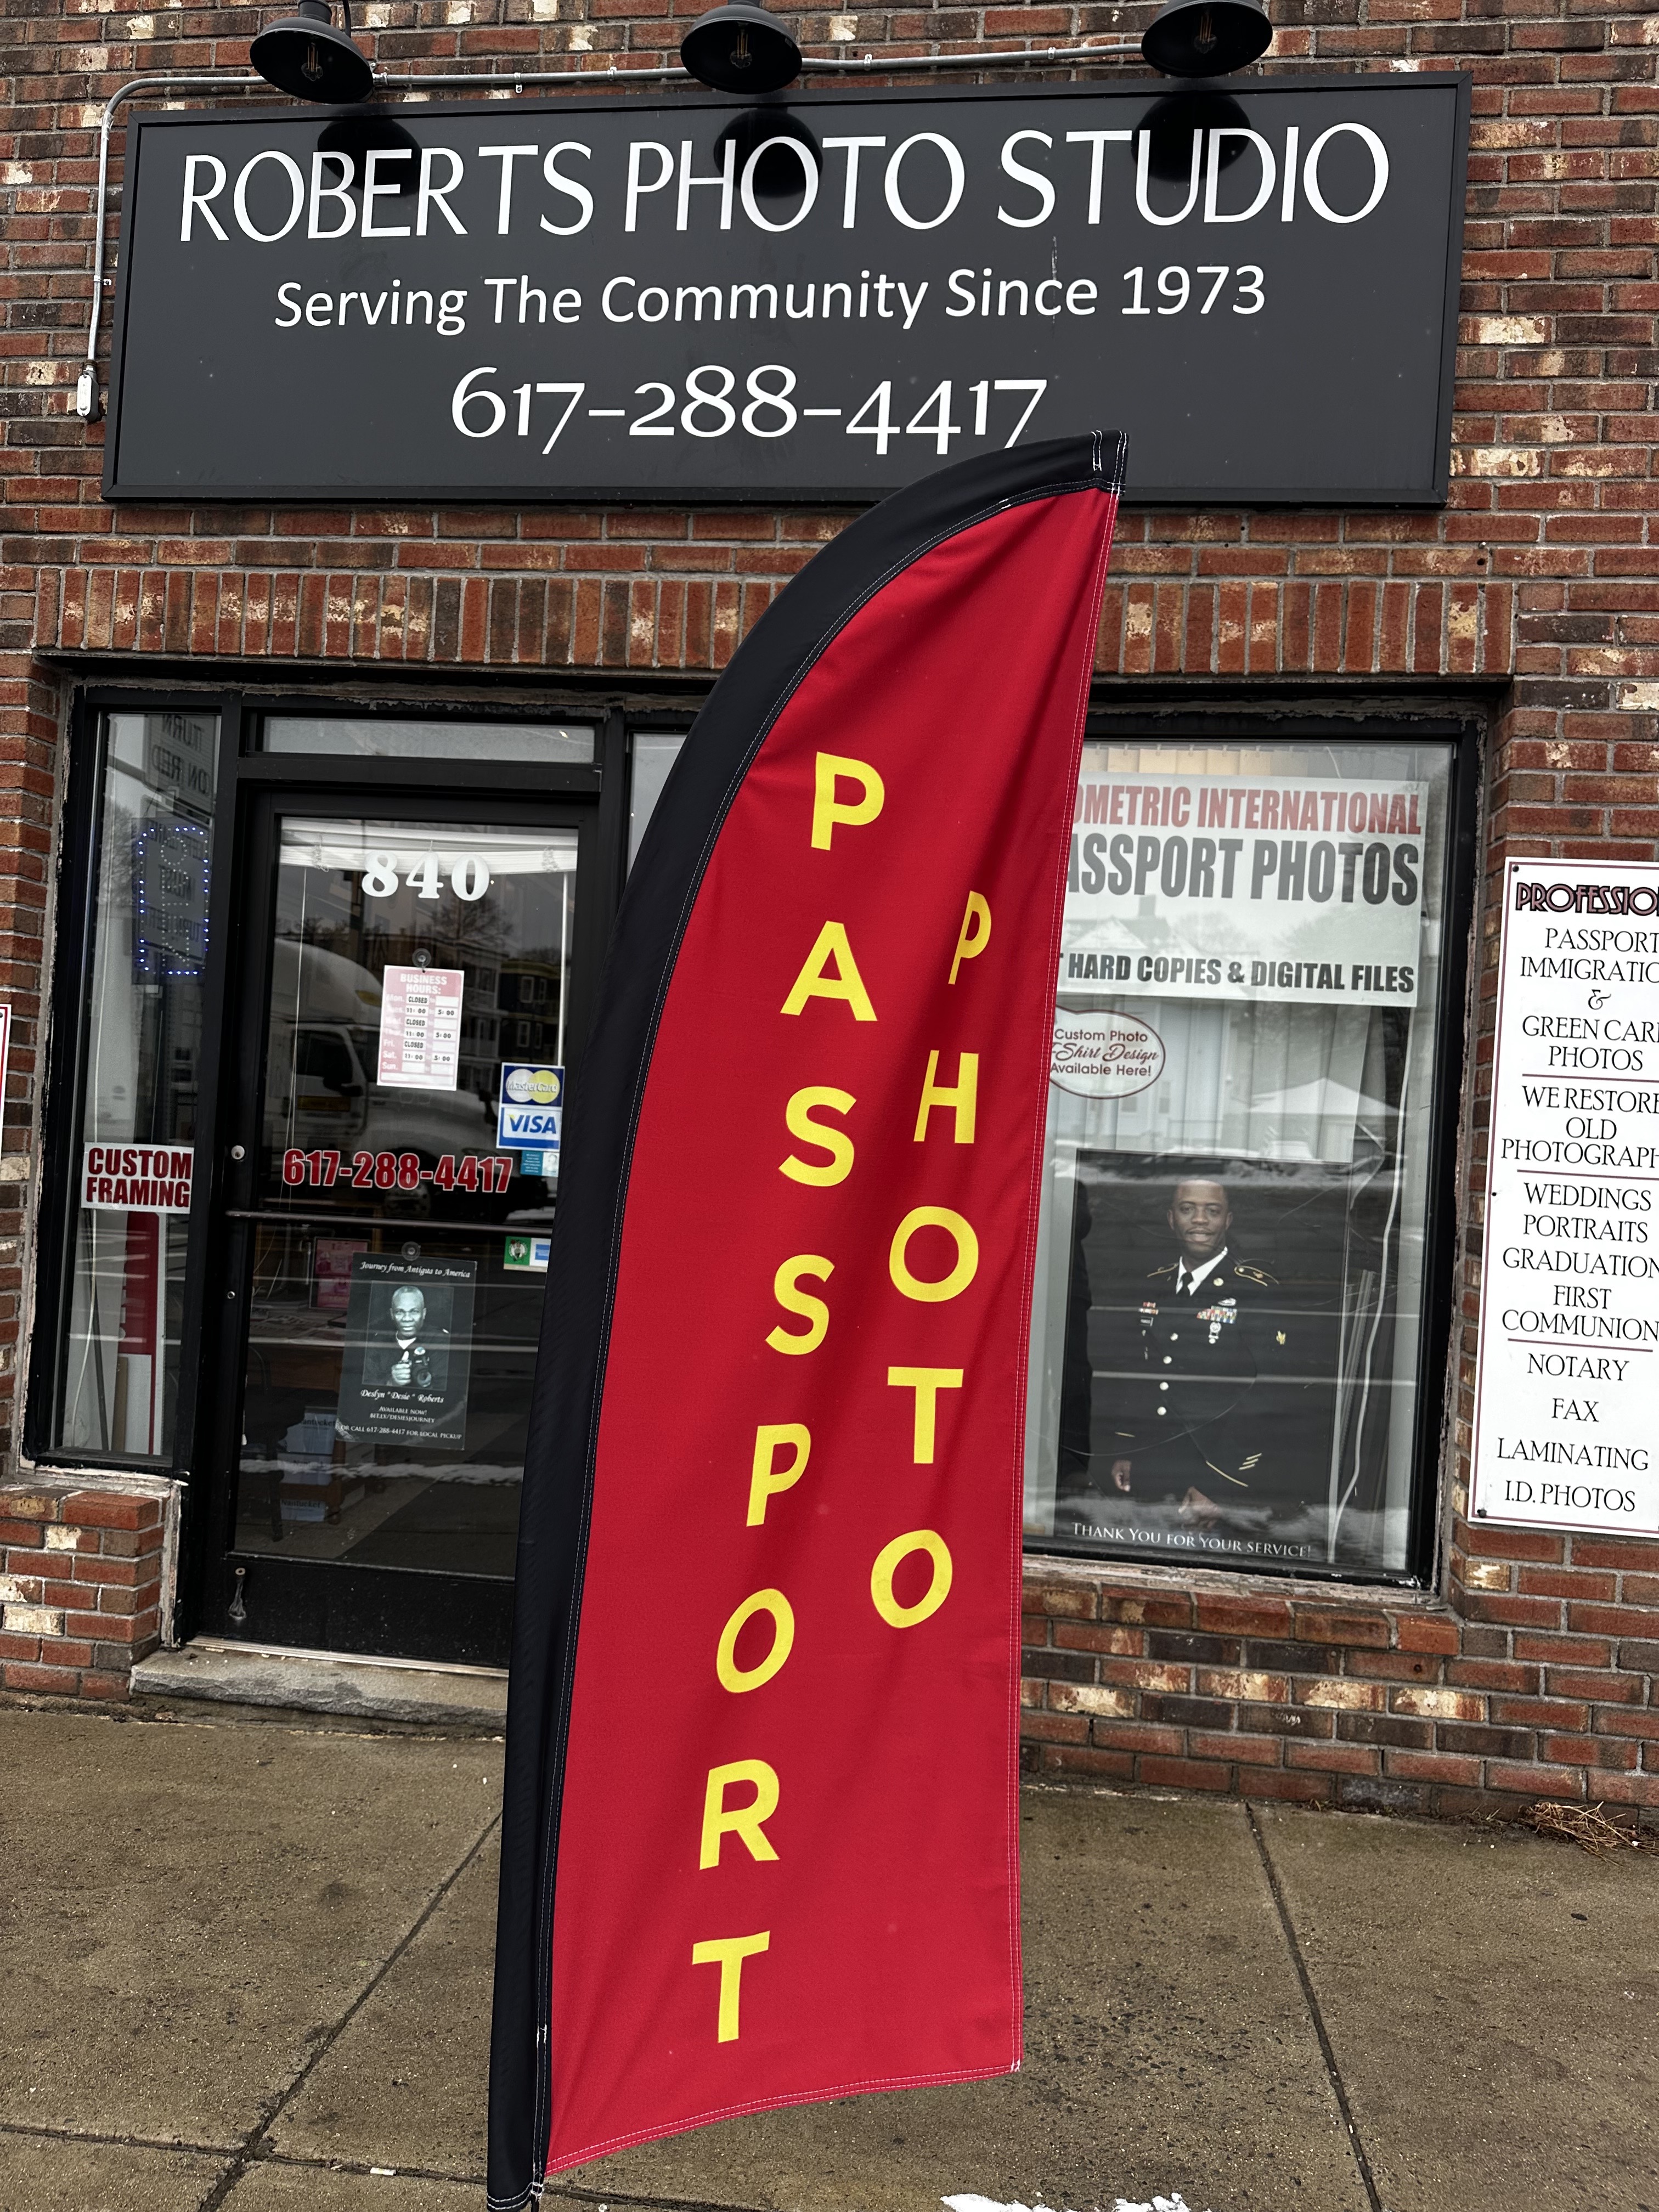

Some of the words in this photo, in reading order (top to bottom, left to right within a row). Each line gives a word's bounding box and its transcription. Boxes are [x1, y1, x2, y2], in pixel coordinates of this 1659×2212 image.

[180, 141, 594, 242] ROBERTS
[624, 132, 964, 233] PHOTO
[997, 122, 1390, 228] STUDIO
[275, 279, 467, 336] Serving
[484, 275, 581, 323] The
[601, 270, 928, 330] Community
[945, 268, 1098, 318] Since
[1121, 266, 1265, 315] 1973
[451, 364, 1047, 455] 617-288-4417
[1197, 787, 1421, 834] INTERNATIONAL
[361, 850, 490, 901] 840
[1250, 838, 1419, 906] PHOTOS
[1515, 882, 1659, 916] PROFESSIO
[1544, 928, 1659, 953] PASSPORT
[400, 974, 447, 985] BUSINESS
[1068, 953, 1131, 980] HARD
[1137, 956, 1221, 985] COPIES
[1227, 961, 1245, 984] &
[1251, 961, 1345, 990] DIGITAL
[1351, 964, 1414, 993] FILES
[1520, 956, 1659, 983] IMMIGRATIO
[406, 984, 441, 994] HOURS:
[408, 996, 428, 1004] CLOSED
[1588, 989, 1612, 1010] &
[406, 1018, 426, 1026] CLOSED
[1054, 1028, 1105, 1041] Custom
[1110, 1030, 1148, 1042] Photo
[1522, 1015, 1600, 1040] GREEN
[1604, 1019, 1659, 1043] CAR
[404, 1040, 424, 1048] CLOSED
[1102, 1043, 1159, 1065] Design
[1548, 1045, 1643, 1071] PHOTOS
[1051, 1063, 1111, 1075] Available
[1116, 1065, 1152, 1076] Here!
[506, 1080, 558, 1093] MasterCard
[1522, 1085, 1560, 1109] WE
[1562, 1087, 1659, 1114] RESTORE
[509, 1114, 557, 1135] VISA
[1566, 1117, 1617, 1139] OLD
[88, 1147, 191, 1180] CUSTOM
[283, 1148, 513, 1193] 617-288-4417
[86, 1176, 190, 1207] FRAMING
[1523, 1182, 1651, 1211] WEDDINGS
[1523, 1214, 1648, 1243] PORTRAITS
[359, 1261, 387, 1273] Journey
[386, 1263, 404, 1273] from
[404, 1265, 433, 1277] Antigua
[442, 1268, 470, 1278] America
[871, 890, 992, 1629] PHOTO
[1503, 1247, 1659, 1278] GRADUATION
[1553, 1284, 1612, 1310] FIRST
[1502, 1310, 1659, 1342] COMMUNION
[1527, 1352, 1629, 1381] NOTARY
[417, 1393, 444, 1403] Roberts
[692, 751, 884, 2042] PASSPORT
[1551, 1398, 1599, 1423] FAX
[366, 1426, 405, 1435] 617-288-4417
[1497, 1437, 1649, 1471] LAMINATING
[1504, 1480, 1536, 1504] I.D.
[1539, 1484, 1635, 1513] PHOTOS
[1071, 1521, 1124, 1540] THANK
[1129, 1527, 1160, 1544] YOU
[1166, 1533, 1195, 1547] FOR
[1199, 1537, 1242, 1552] YOUR
[1246, 1542, 1312, 1558] SERVICE!
